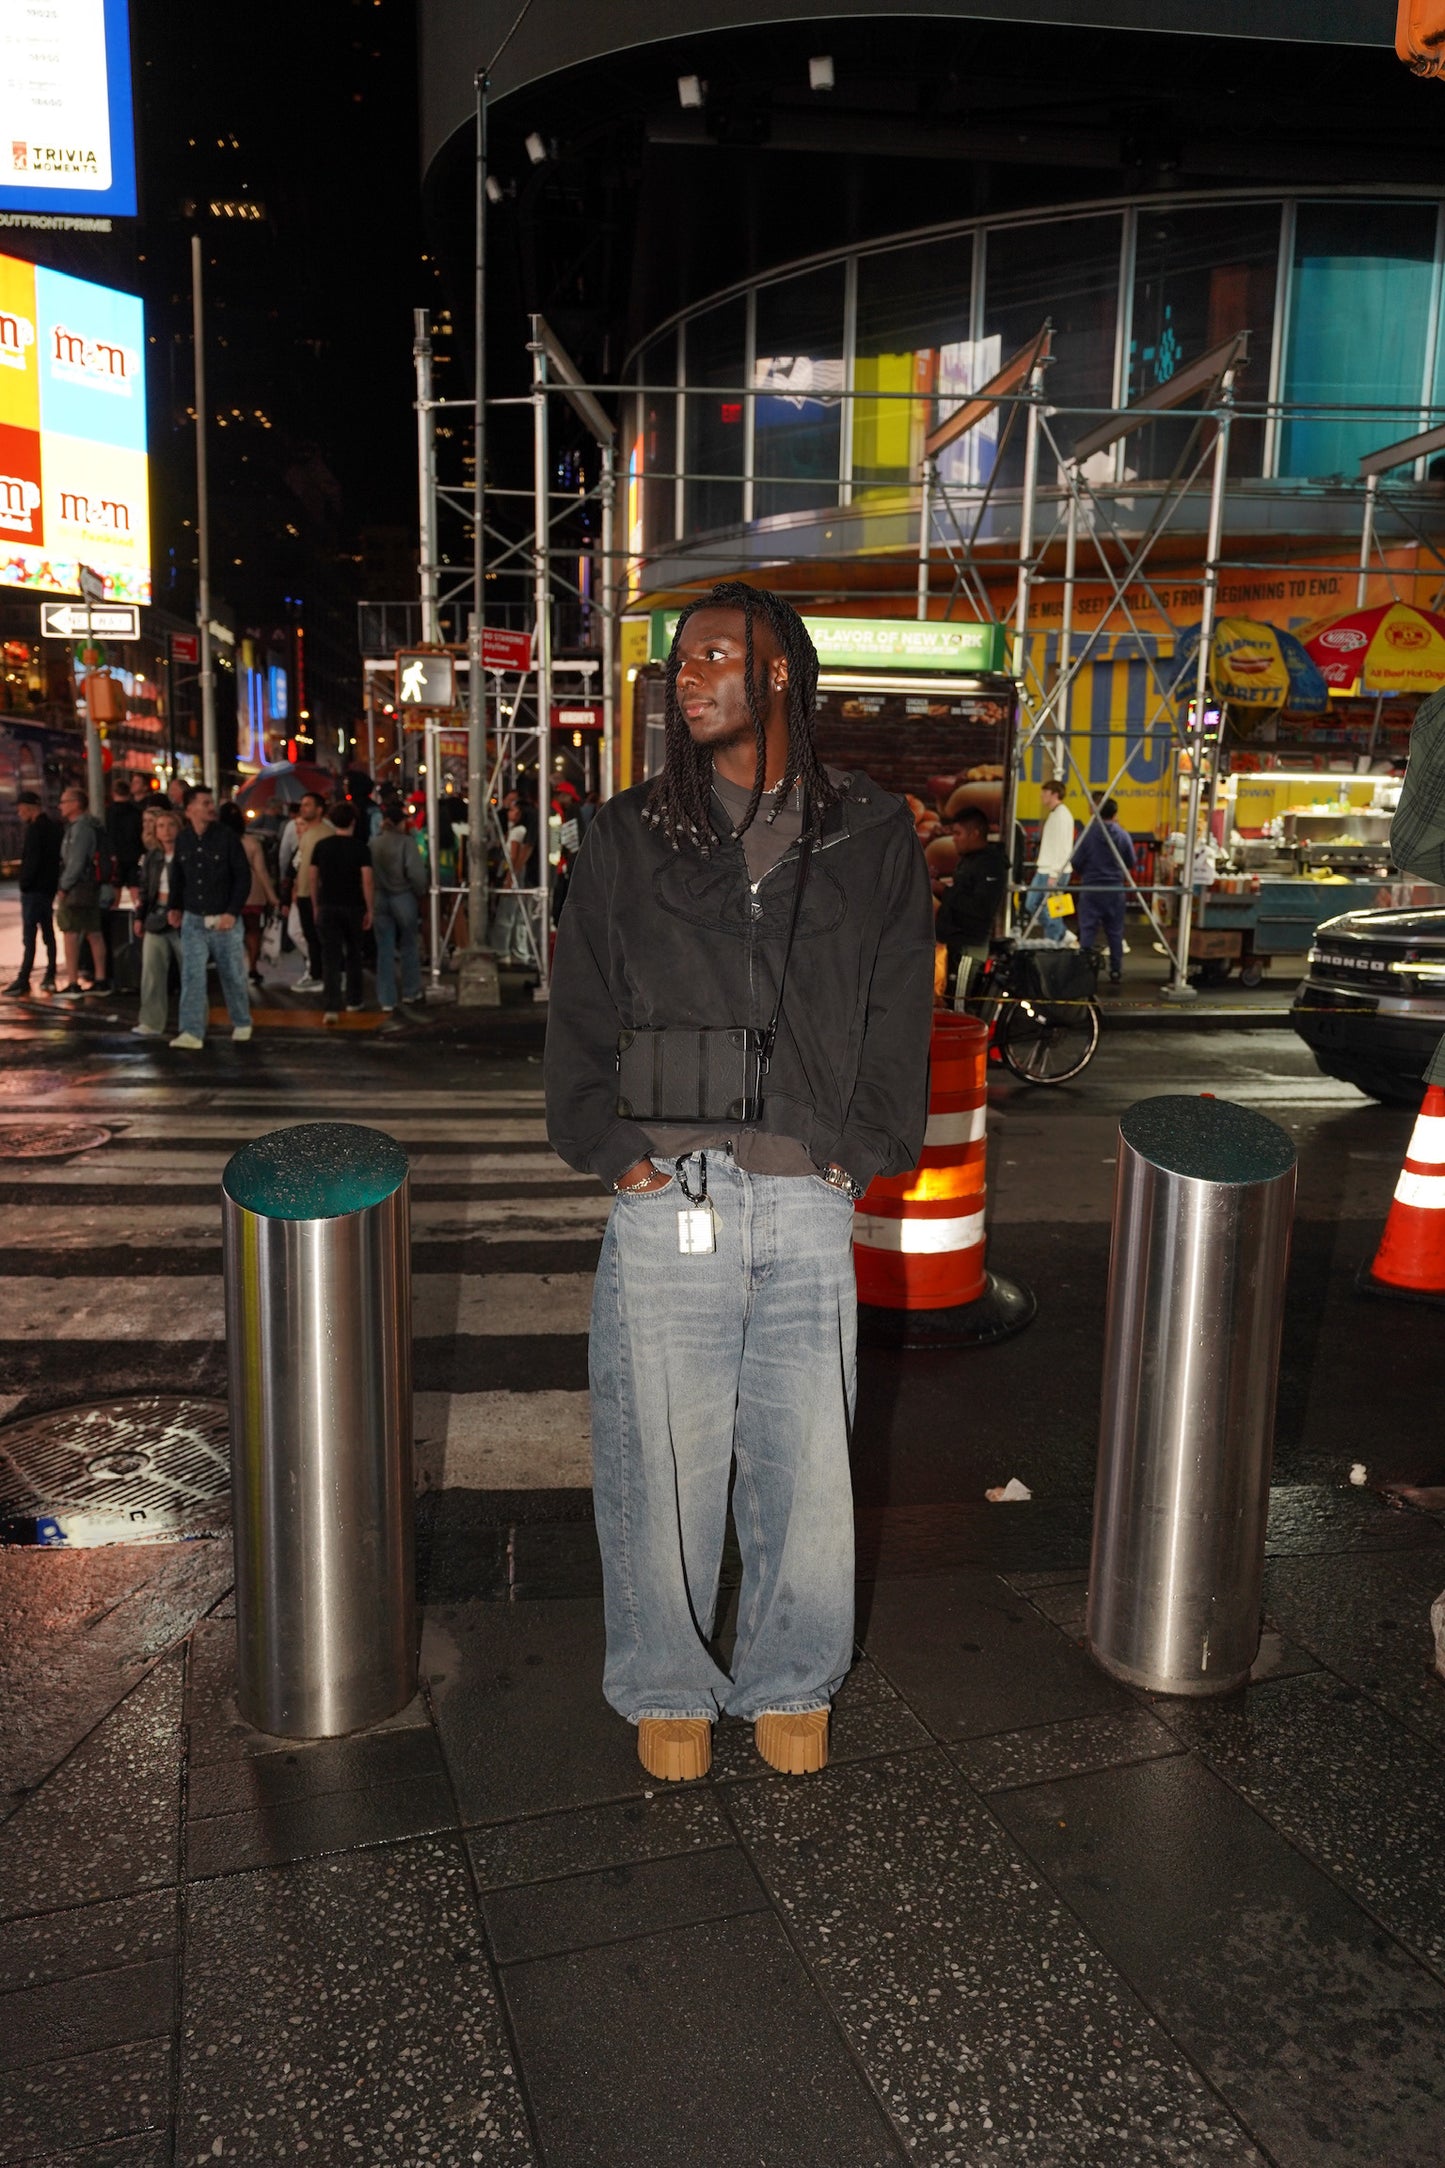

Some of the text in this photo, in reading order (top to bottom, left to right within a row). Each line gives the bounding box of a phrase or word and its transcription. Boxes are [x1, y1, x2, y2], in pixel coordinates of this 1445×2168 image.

[33, 147, 97, 163] TRIVIA
[33, 163, 98, 174] MOMENTS
[1289, 578, 1306, 598] TO
[814, 629, 874, 644] FLAVOR
[877, 631, 899, 644] OF
[901, 632, 937, 647] NEW
[1314, 953, 1385, 972] BRONCO
